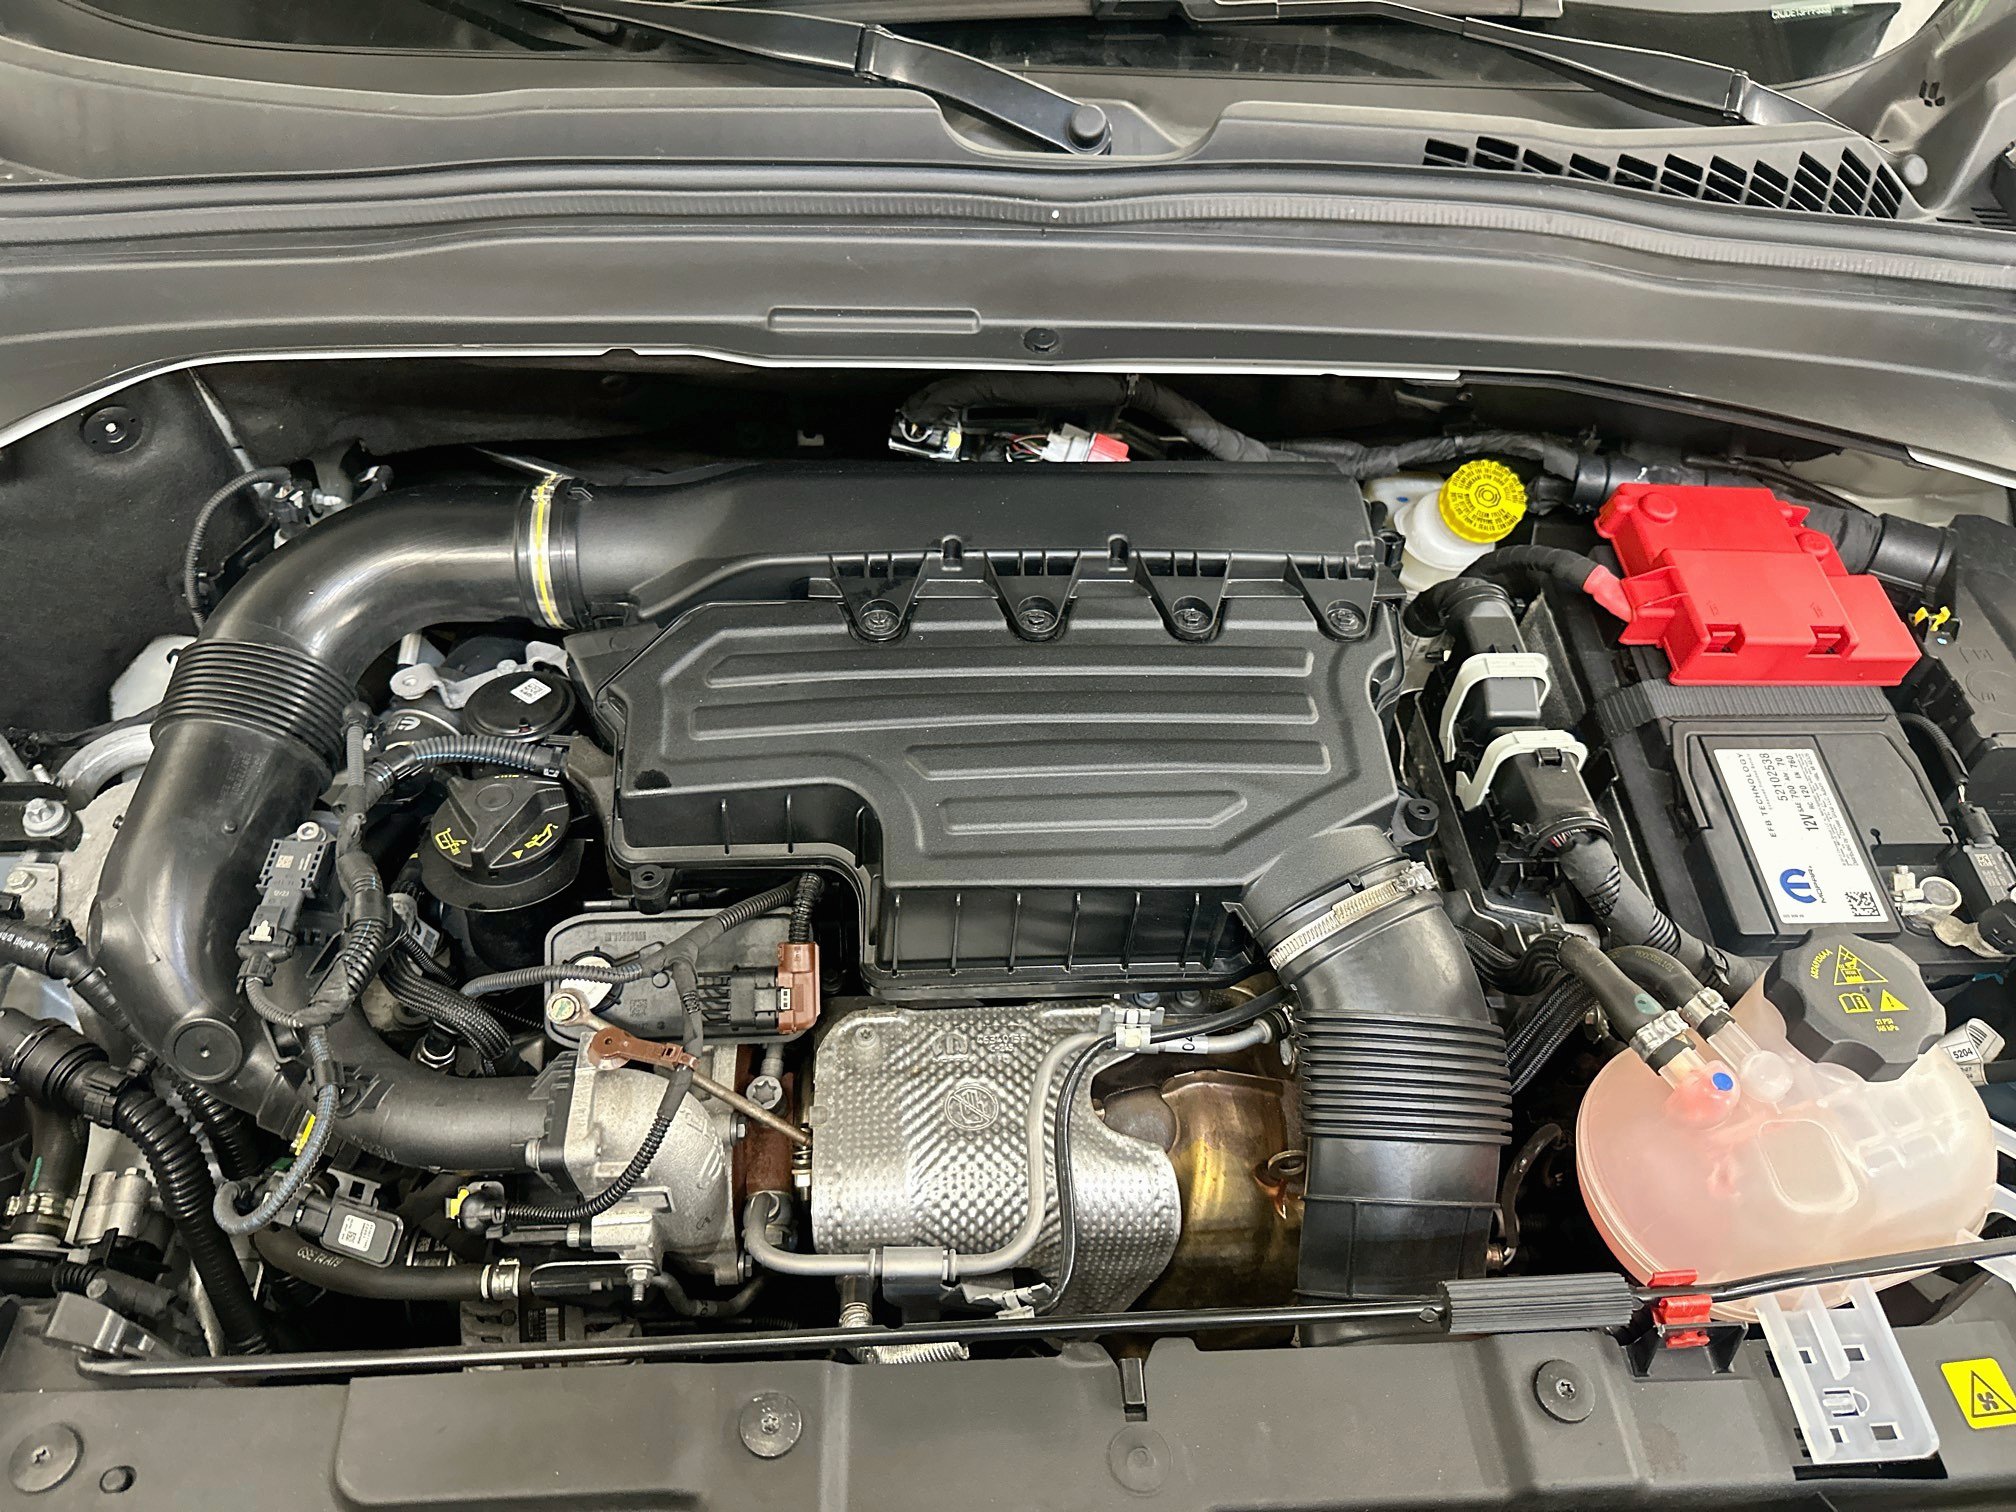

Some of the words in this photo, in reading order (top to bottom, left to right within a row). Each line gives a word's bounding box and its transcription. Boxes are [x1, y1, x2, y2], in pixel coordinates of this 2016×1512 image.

[1775, 758, 1785, 766] 70
[1786, 756, 1798, 768] 760
[1759, 753, 1789, 801] 52102538
[1737, 753, 1768, 816] TECHNOLOGY
[1787, 786, 1799, 799] 700
[1800, 785, 1811, 798] 120
[1764, 820, 1777, 838] EFB
[1799, 814, 1820, 831] 12V
[1952, 1047, 1974, 1059] 5204
